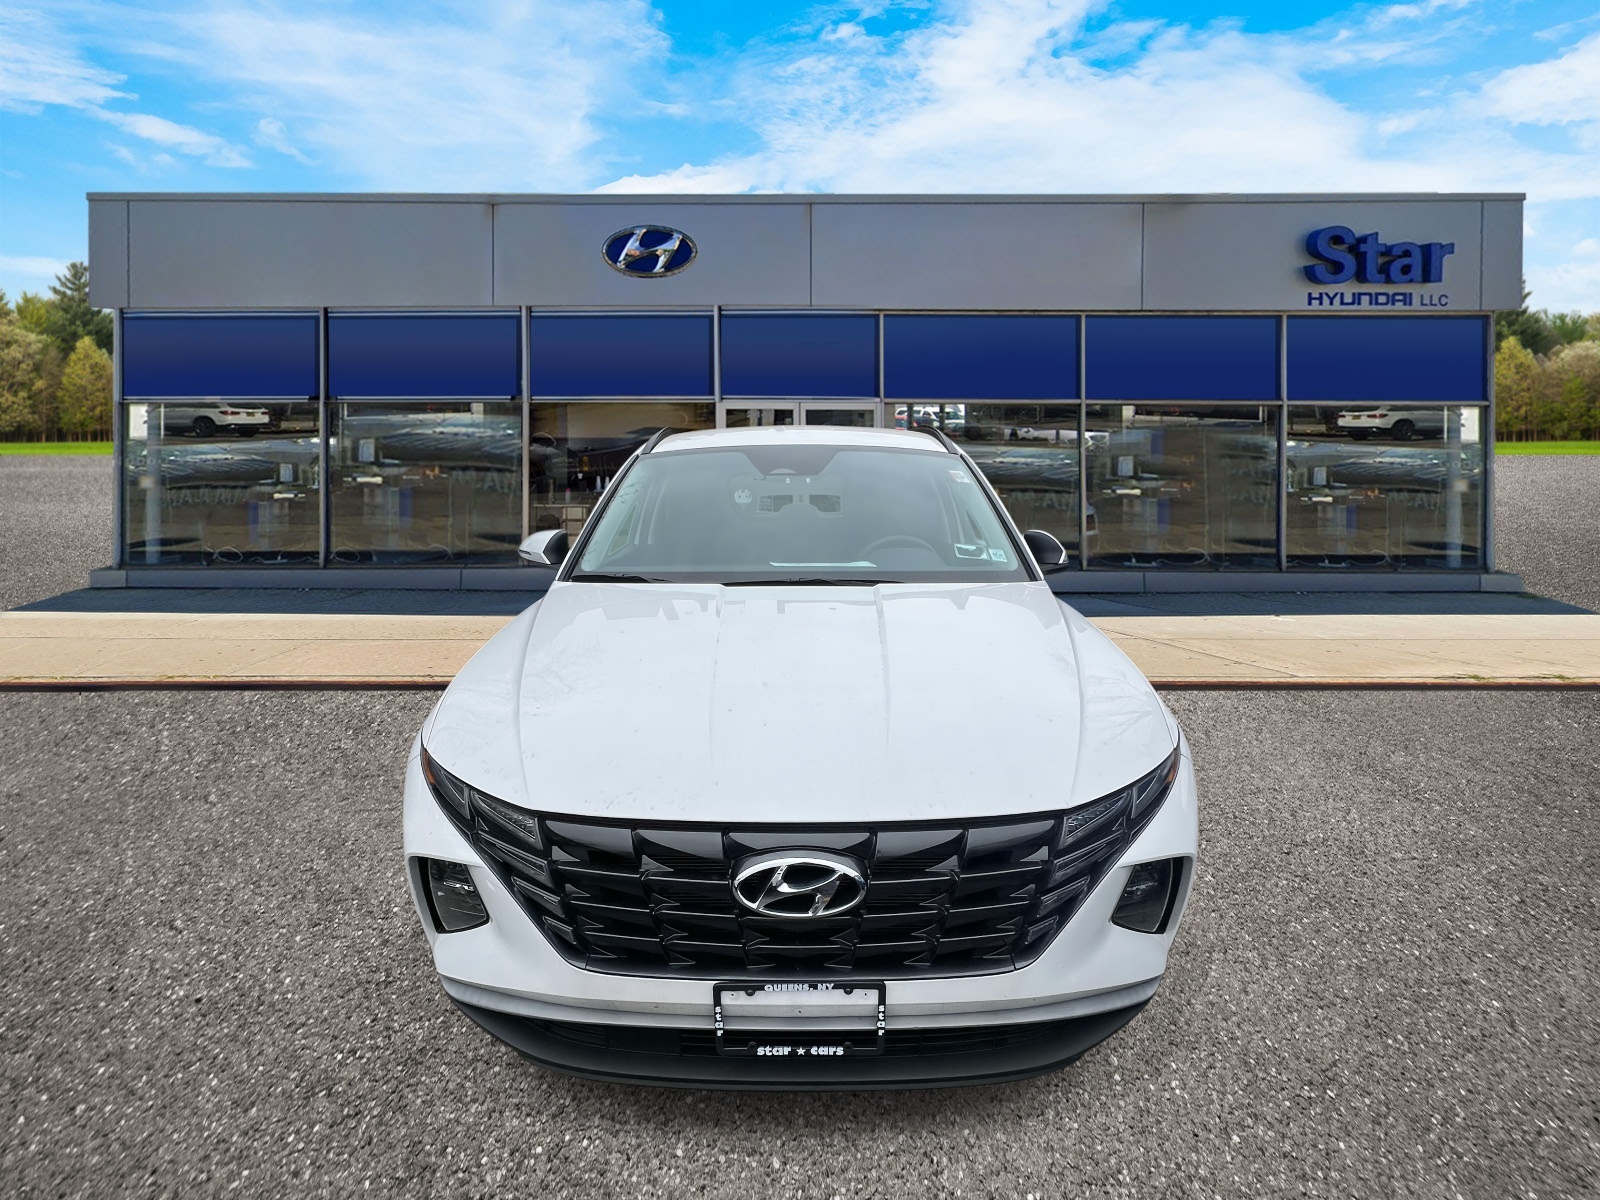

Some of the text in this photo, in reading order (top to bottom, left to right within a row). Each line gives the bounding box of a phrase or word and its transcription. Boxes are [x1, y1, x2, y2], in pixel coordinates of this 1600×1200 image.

[1304, 225, 1455, 284] Star
[1307, 292, 1449, 306] HYUNDAI LLC
[764, 983, 834, 992] QUEENS, NY
[715, 1006, 724, 1037] star
[877, 1005, 886, 1036] star
[756, 1044, 844, 1056] star cars
